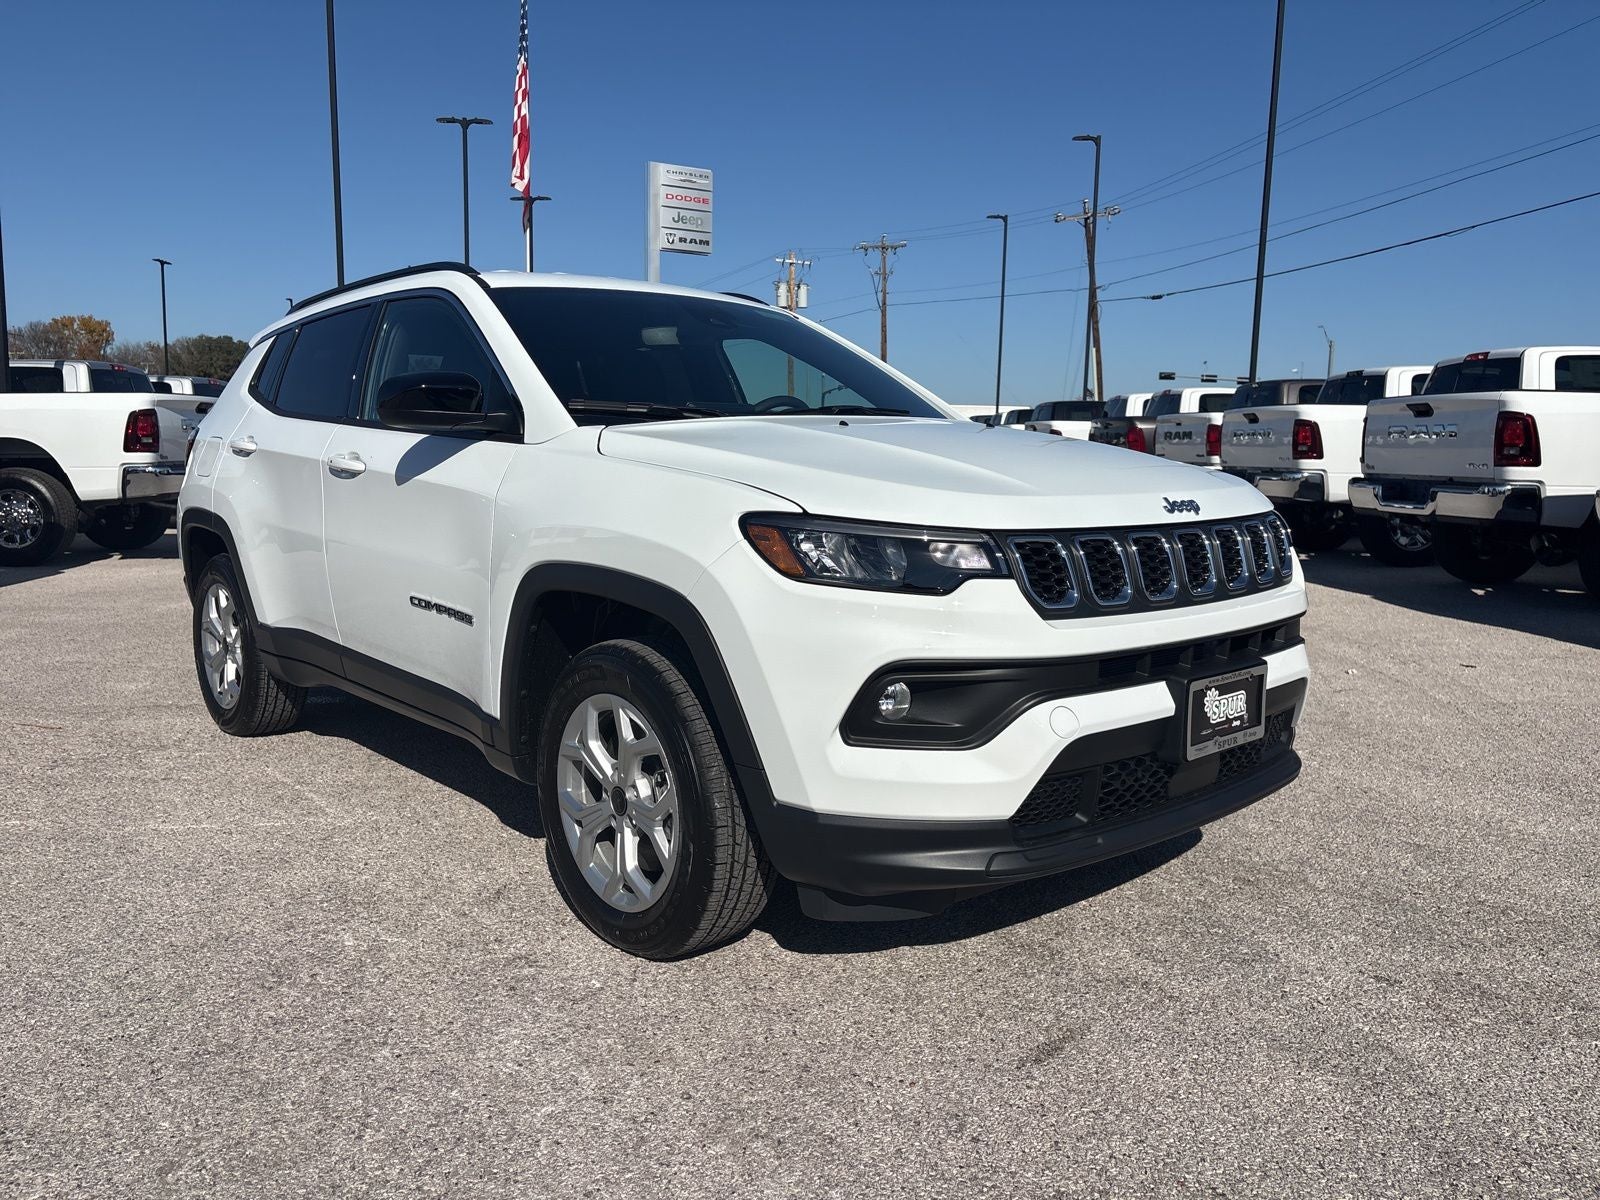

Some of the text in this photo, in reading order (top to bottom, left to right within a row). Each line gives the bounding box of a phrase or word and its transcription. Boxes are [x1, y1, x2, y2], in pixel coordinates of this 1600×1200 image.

[666, 170, 709, 179] CHRYSLER
[665, 193, 710, 204] DODGE
[672, 211, 703, 228] Jeep
[679, 236, 710, 246] RAM
[1164, 430, 1193, 441] RAM
[1162, 496, 1201, 516] Jeep
[409, 595, 474, 627] COMPASS
[1212, 692, 1246, 721] SPUR
[1217, 737, 1238, 750] SPUR
